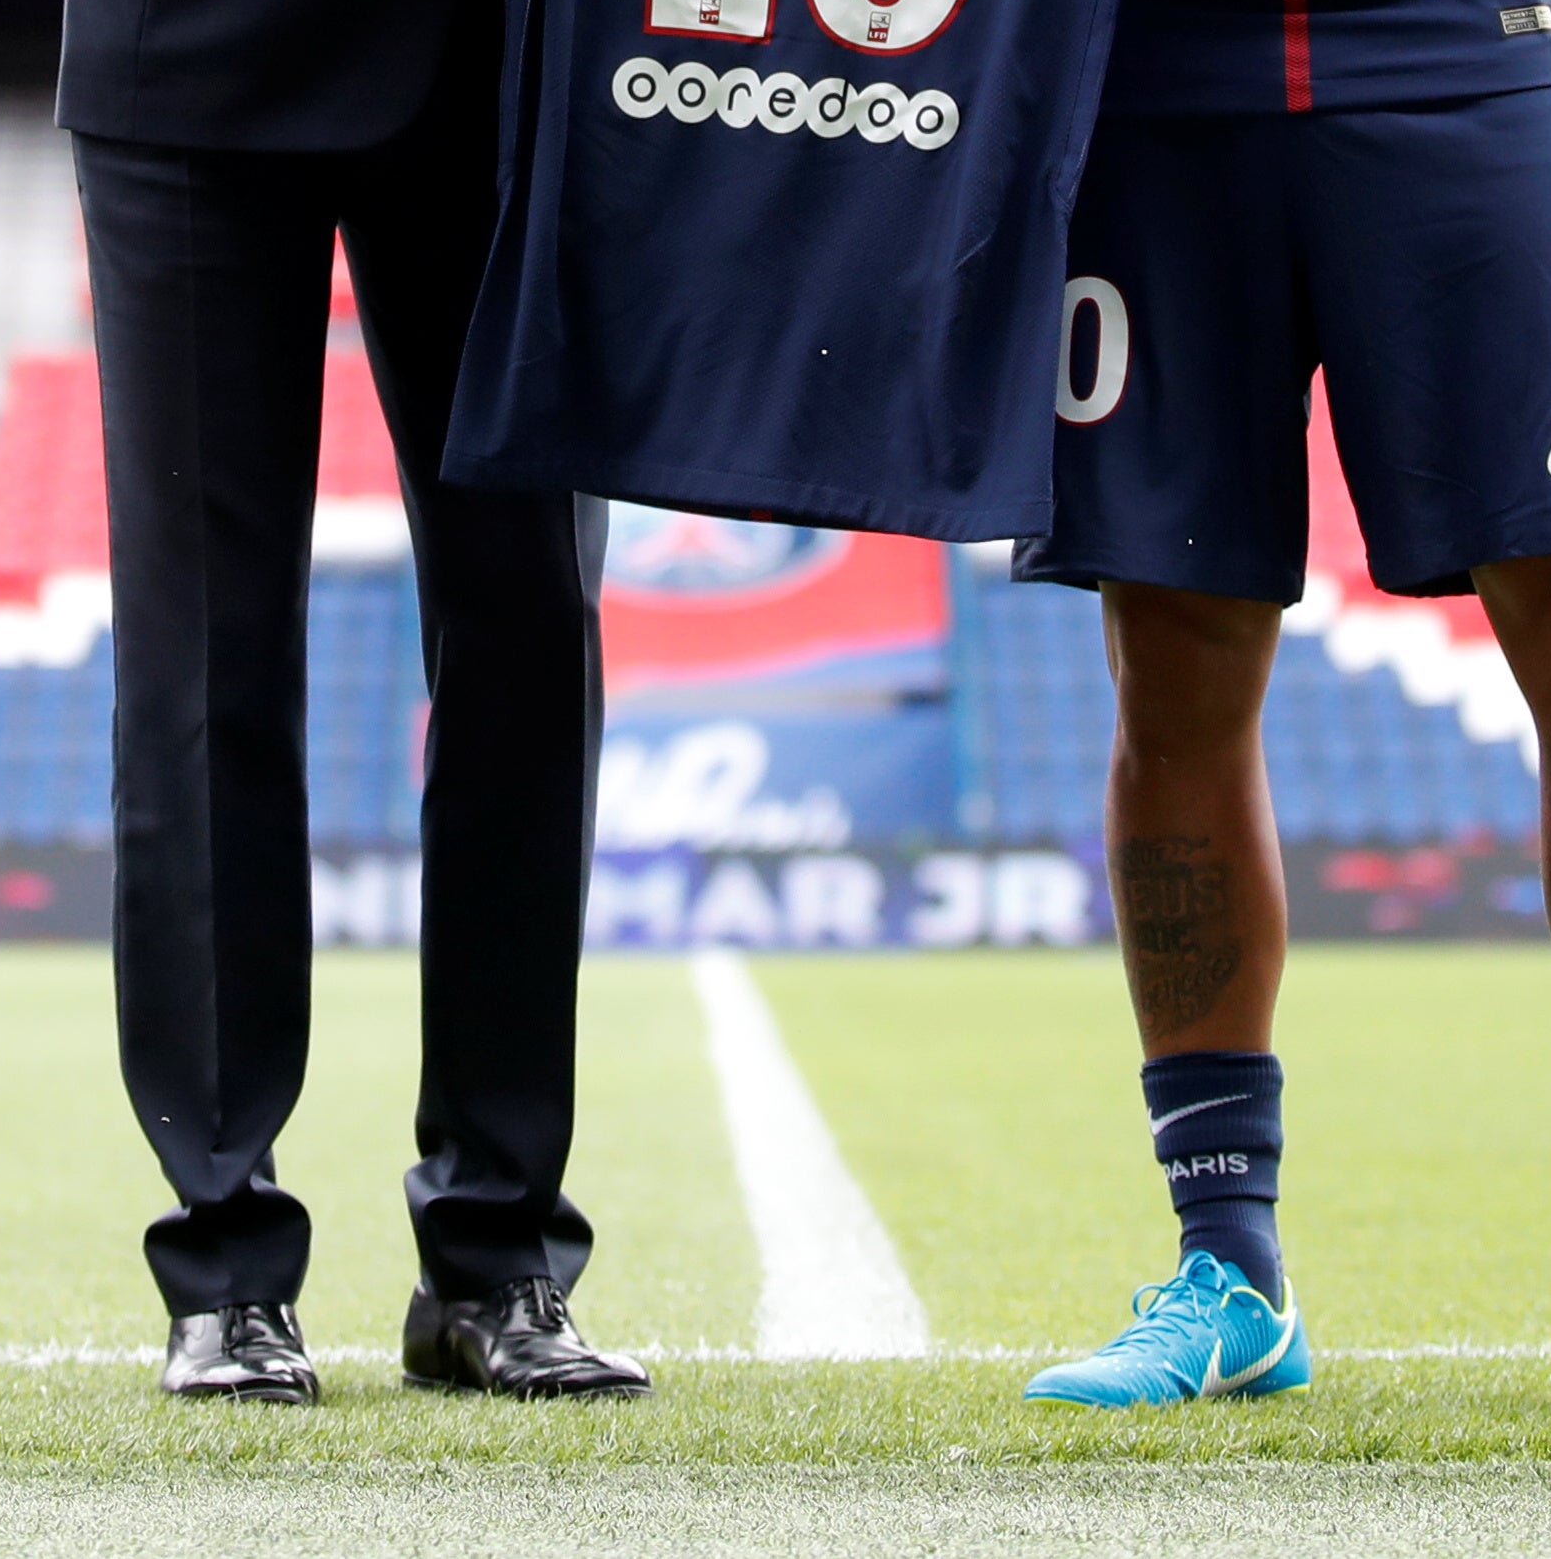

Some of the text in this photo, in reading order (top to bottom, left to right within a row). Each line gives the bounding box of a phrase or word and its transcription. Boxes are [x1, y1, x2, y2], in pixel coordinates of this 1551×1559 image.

[700, 13, 719, 22] LFP
[868, 30, 888, 40] LFP
[617, 62, 954, 146] ooredoo
[910, 854, 1092, 947] JR
